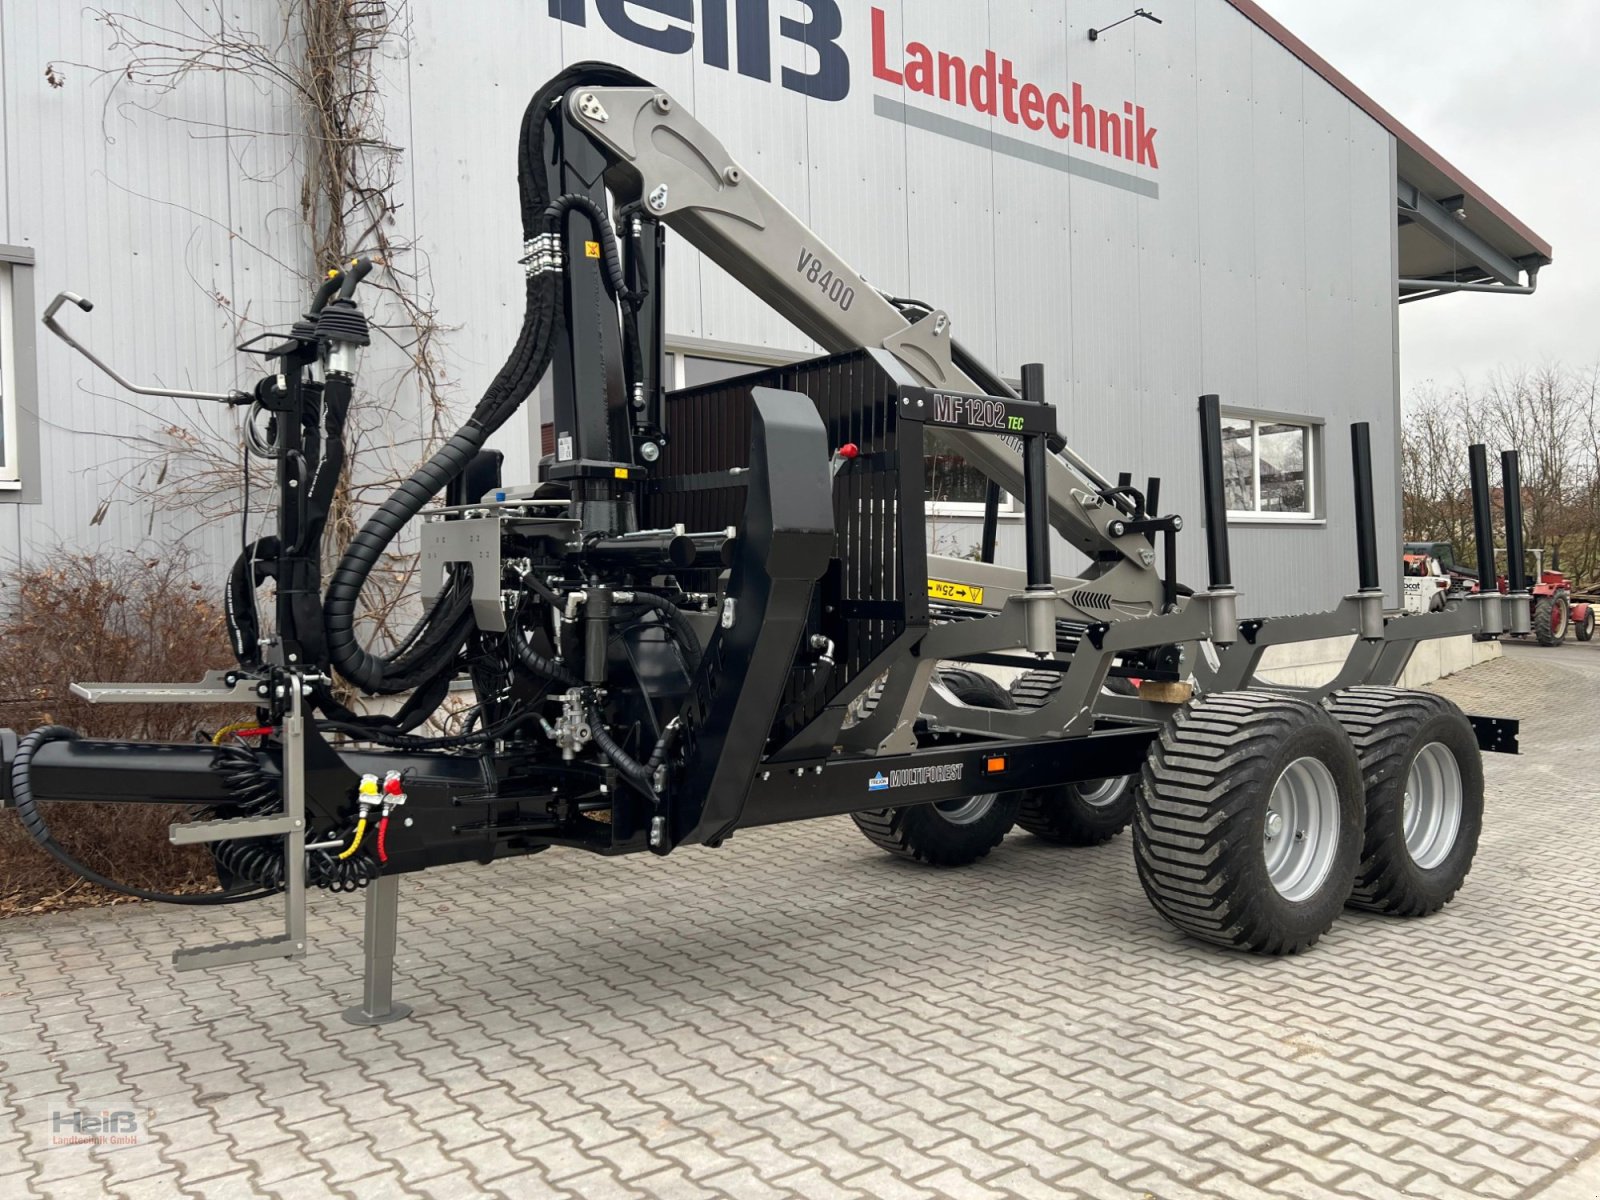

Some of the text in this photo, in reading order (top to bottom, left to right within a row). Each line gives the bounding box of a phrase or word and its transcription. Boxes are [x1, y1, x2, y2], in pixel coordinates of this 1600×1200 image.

[548, 0, 850, 102] eiß
[871, 6, 1159, 169] Landtechnik
[797, 247, 855, 311] V8400
[933, 393, 1024, 430] MF 1202 TEC
[890, 763, 964, 788] MULTIFOREST
